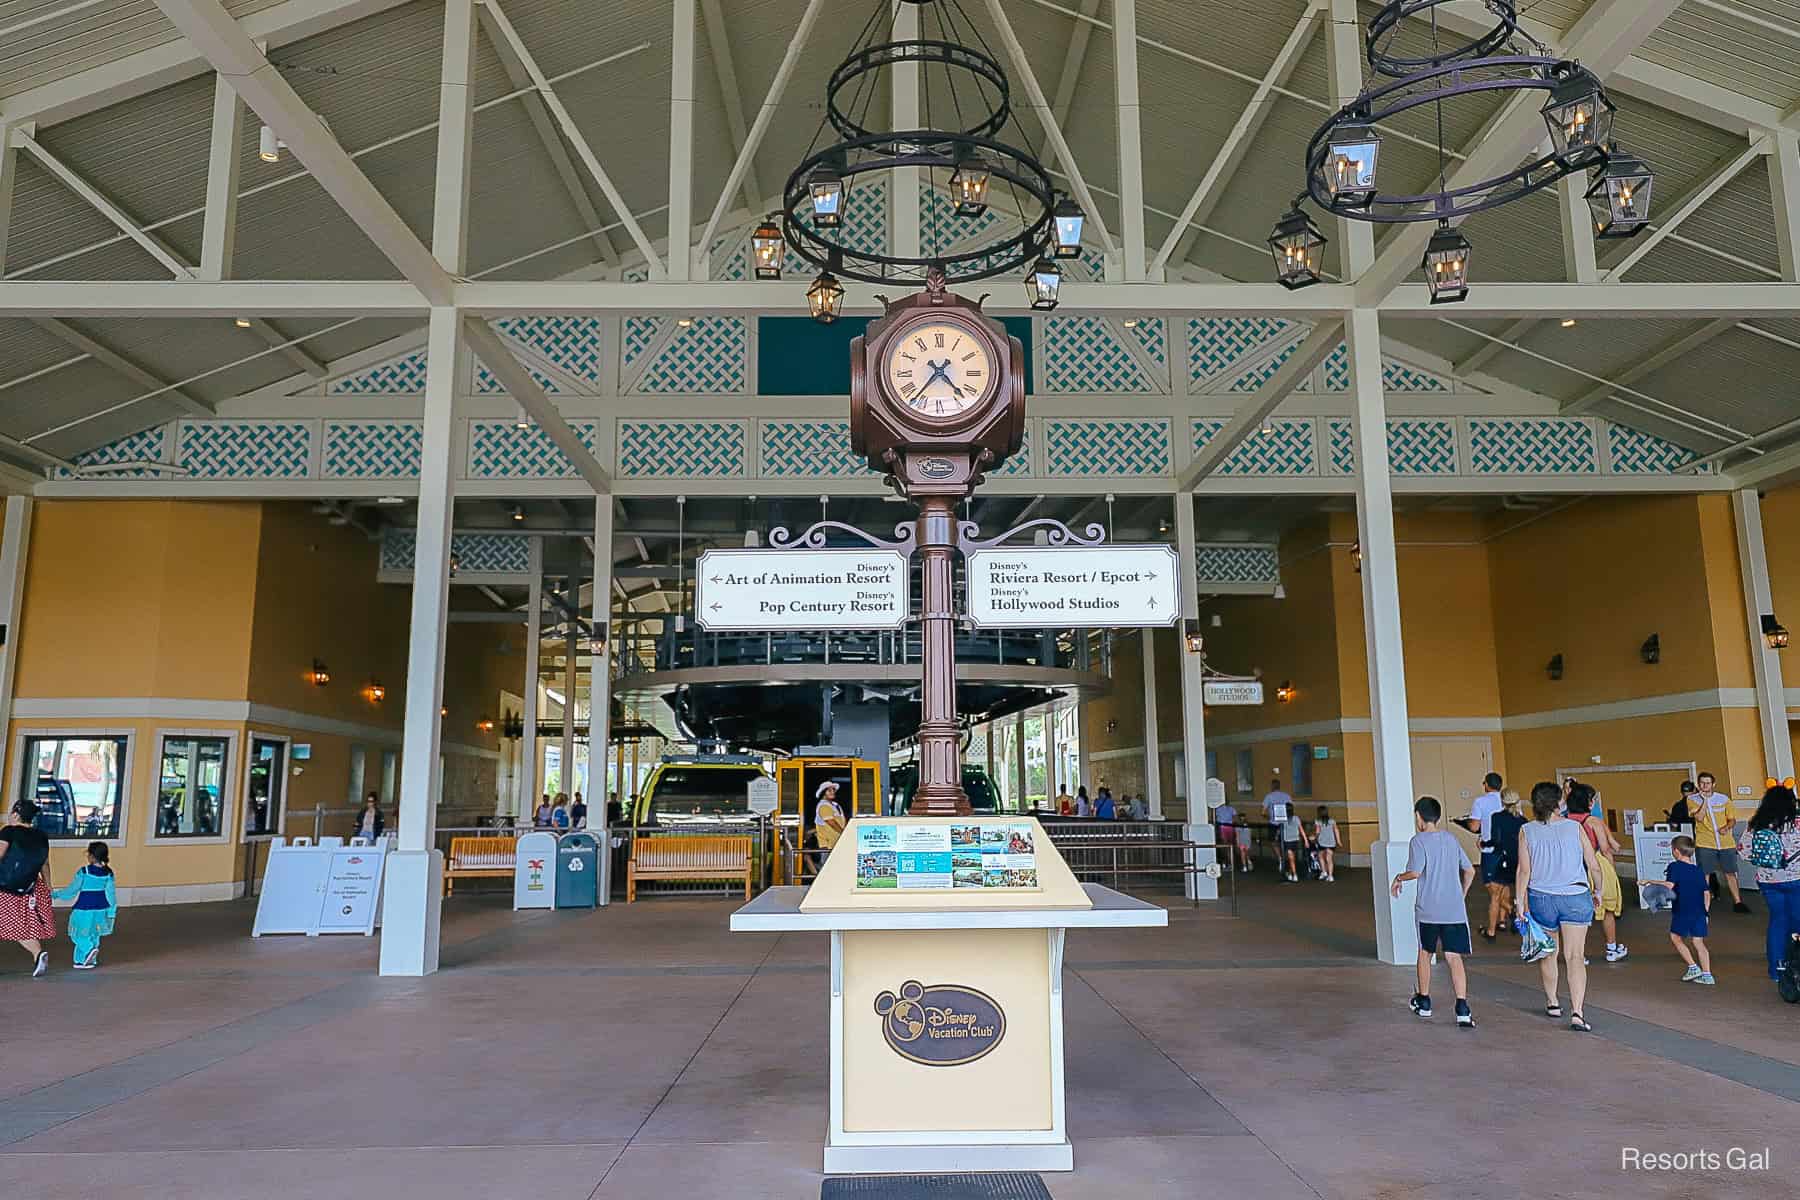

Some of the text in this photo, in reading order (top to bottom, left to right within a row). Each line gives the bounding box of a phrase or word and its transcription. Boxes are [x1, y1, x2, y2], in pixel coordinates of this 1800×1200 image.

[934, 333, 945, 348] XII
[857, 563, 895, 572] Disney's
[989, 561, 1028, 571] Disney's
[725, 572, 892, 585] Art of Animation Resort
[990, 572, 1039, 583] Riviera
[1044, 571, 1088, 583] Resort
[1100, 571, 1141, 584] Epcot
[856, 591, 895, 600] Disney's
[991, 588, 1029, 597] Disney's
[759, 600, 896, 615] Pop Century Resort
[991, 597, 1120, 612] Hollywood Studios
[928, 1025, 995, 1039] Vacation Club
